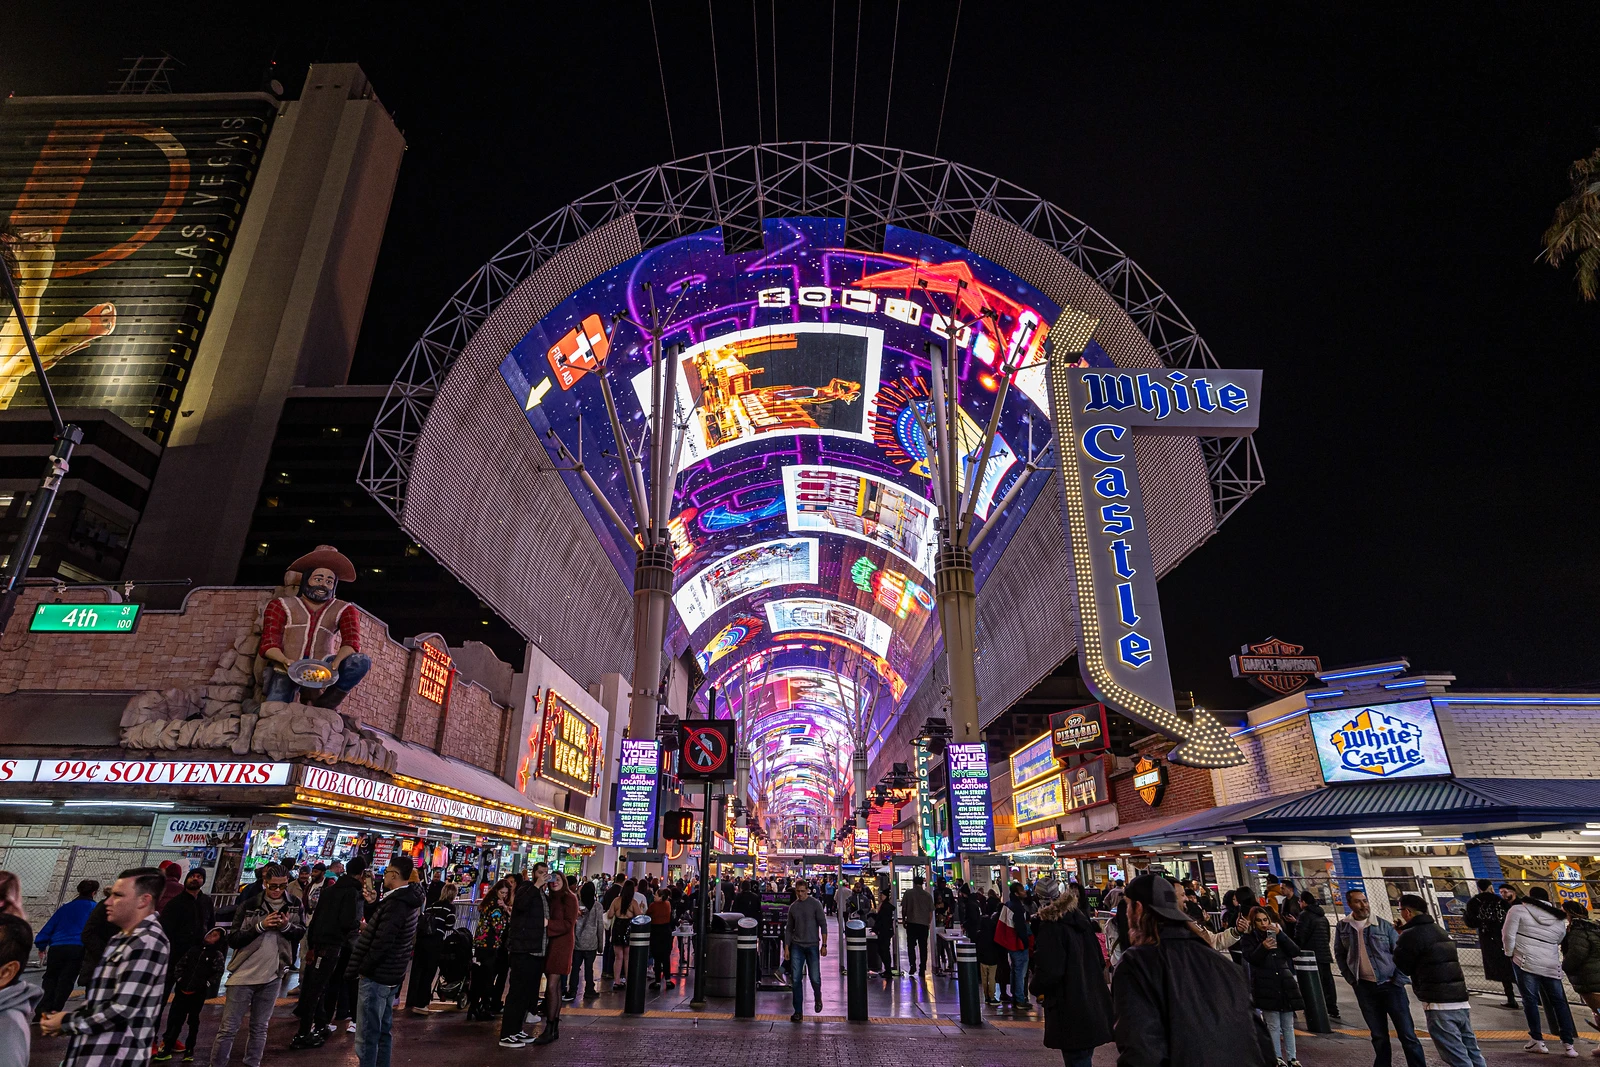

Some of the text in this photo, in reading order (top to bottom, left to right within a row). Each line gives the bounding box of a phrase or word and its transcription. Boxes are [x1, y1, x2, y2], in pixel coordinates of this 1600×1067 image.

[165, 118, 245, 278] LAS VEGAS
[561, 373, 574, 386] AID
[1080, 371, 1249, 420] White
[1081, 424, 1152, 669] Castle
[38, 606, 46, 614] N
[62, 608, 98, 627] 4th
[121, 606, 130, 615] St
[117, 620, 132, 628] 100
[1242, 658, 1318, 671] HARLEY-DAVIDSON
[563, 710, 587, 752] VIVA
[1057, 728, 1080, 741] PIZZA
[1081, 724, 1097, 736] BAR
[1341, 726, 1412, 750] White
[623, 741, 654, 749] TIME
[949, 745, 981, 753] TIME
[555, 739, 590, 783] VEGAS
[622, 749, 657, 758] YOUR
[622, 757, 657, 766] LIFE
[950, 753, 986, 761] YOUR
[1342, 746, 1421, 767] Castle
[53, 761, 274, 784] 99¢ SOUVENIRS
[308, 766, 373, 798] TOBACCO
[404, 788, 448, 816] T-SHIRTS
[465, 804, 504, 824] SOUVENIRS
[506, 812, 522, 830] BEER
[170, 820, 246, 832] COLDEST BEER
[565, 820, 576, 832] HATS
[578, 824, 595, 836] LIQUOR
[173, 833, 206, 844] IN TOWN
[1560, 890, 1587, 898] Open
